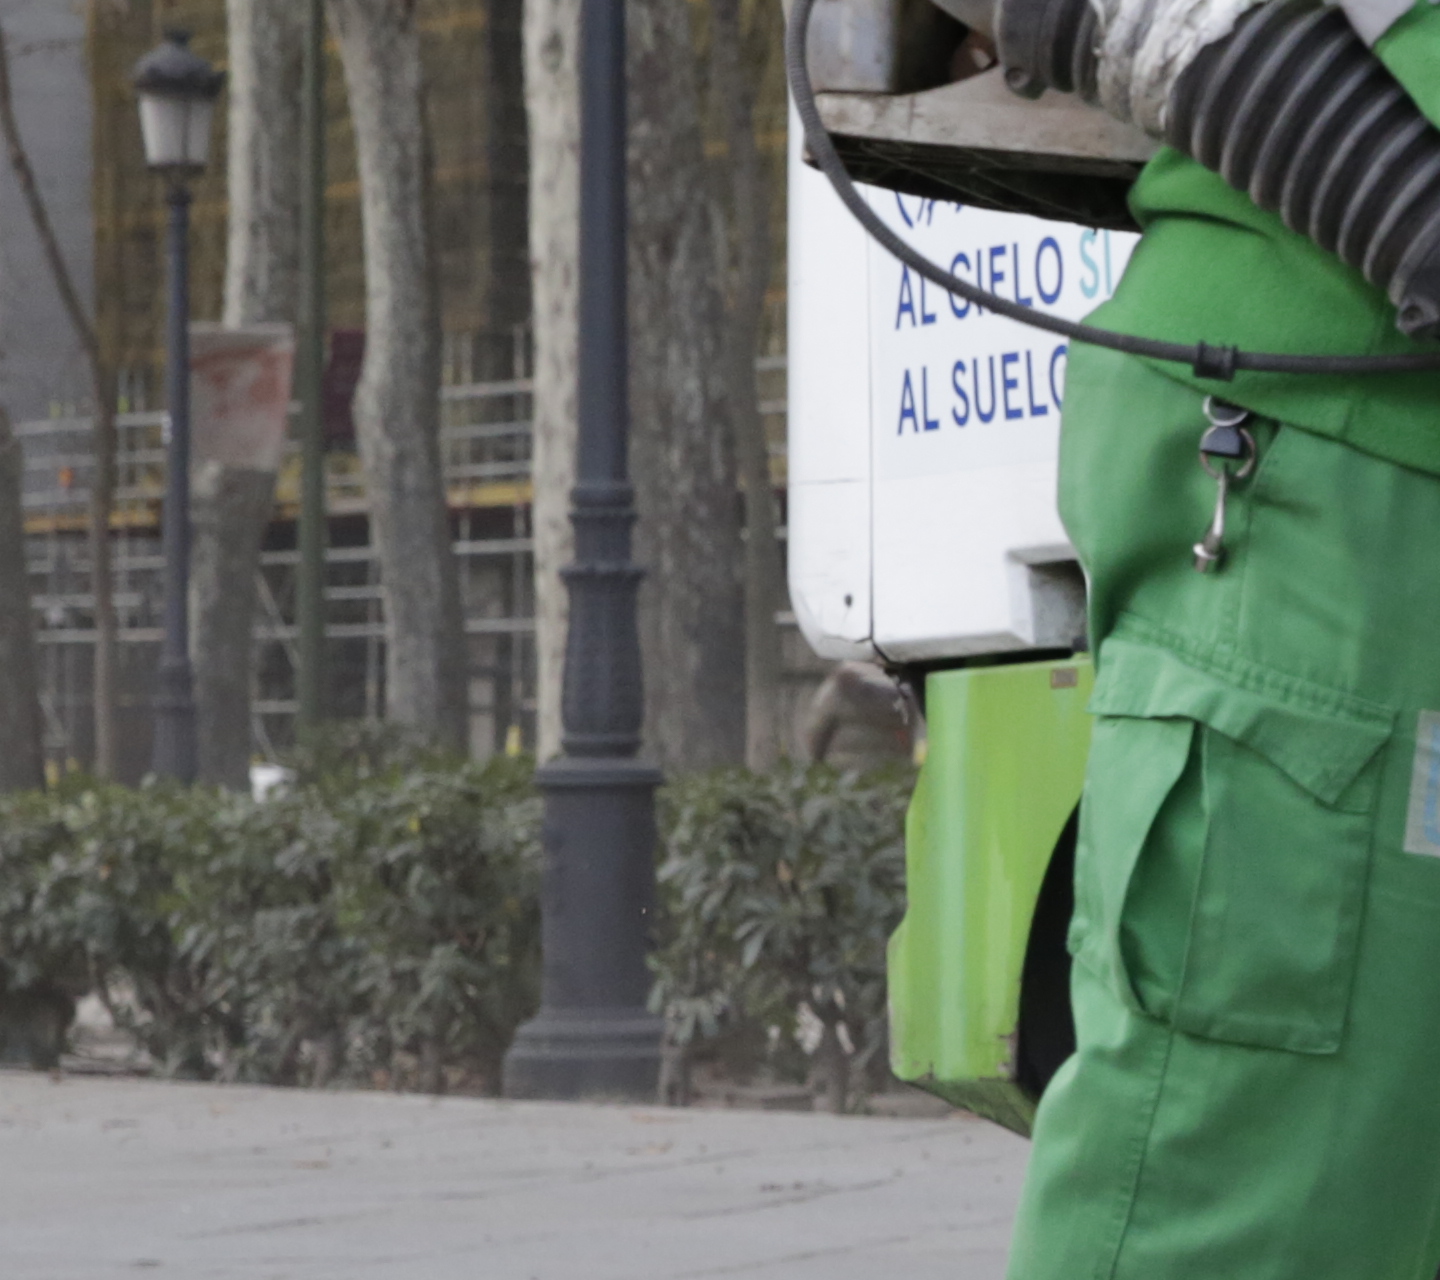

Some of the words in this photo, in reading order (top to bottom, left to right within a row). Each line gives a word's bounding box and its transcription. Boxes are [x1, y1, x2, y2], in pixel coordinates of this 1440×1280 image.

[896, 263, 937, 331] AL
[949, 235, 1063, 320] CIELO
[897, 366, 940, 437] AL
